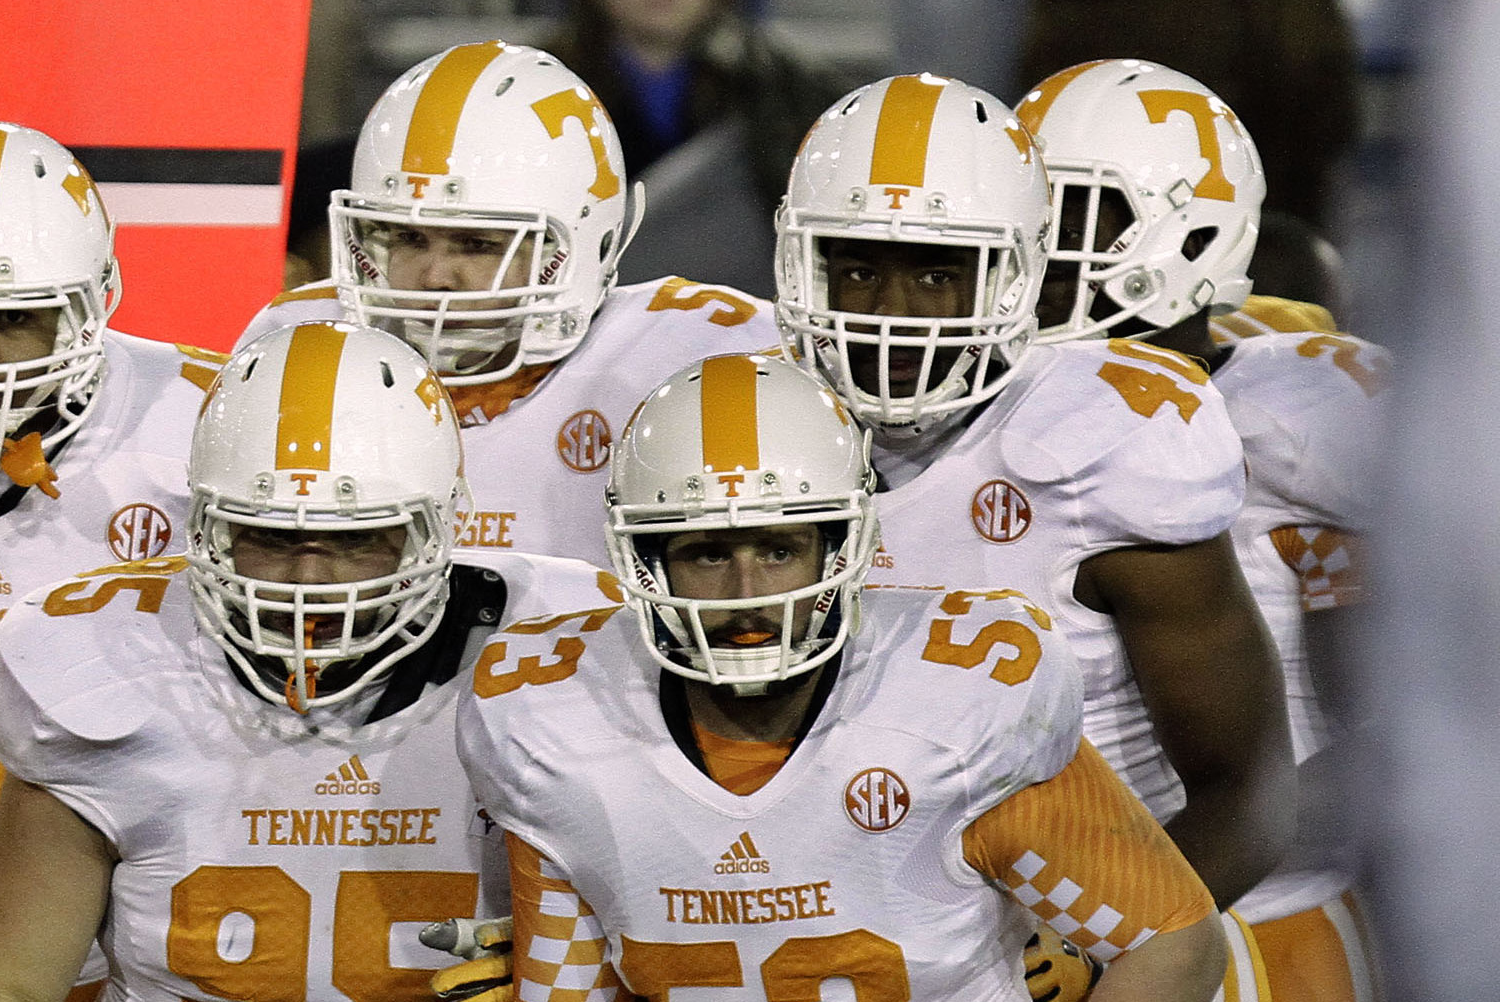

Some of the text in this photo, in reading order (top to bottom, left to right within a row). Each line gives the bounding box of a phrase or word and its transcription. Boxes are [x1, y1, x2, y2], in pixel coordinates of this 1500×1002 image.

[407, 176, 430, 198] T
[884, 187, 910, 209] T
[290, 473, 317, 496] T
[717, 475, 744, 497] T
[972, 481, 1032, 543] SEC
[108, 503, 172, 563] SEC
[315, 779, 381, 795] adidas
[845, 770, 911, 831] SEC
[242, 807, 441, 846] TENNESSEE
[713, 859, 771, 875] adidas
[659, 881, 835, 925] TENNESSEE
